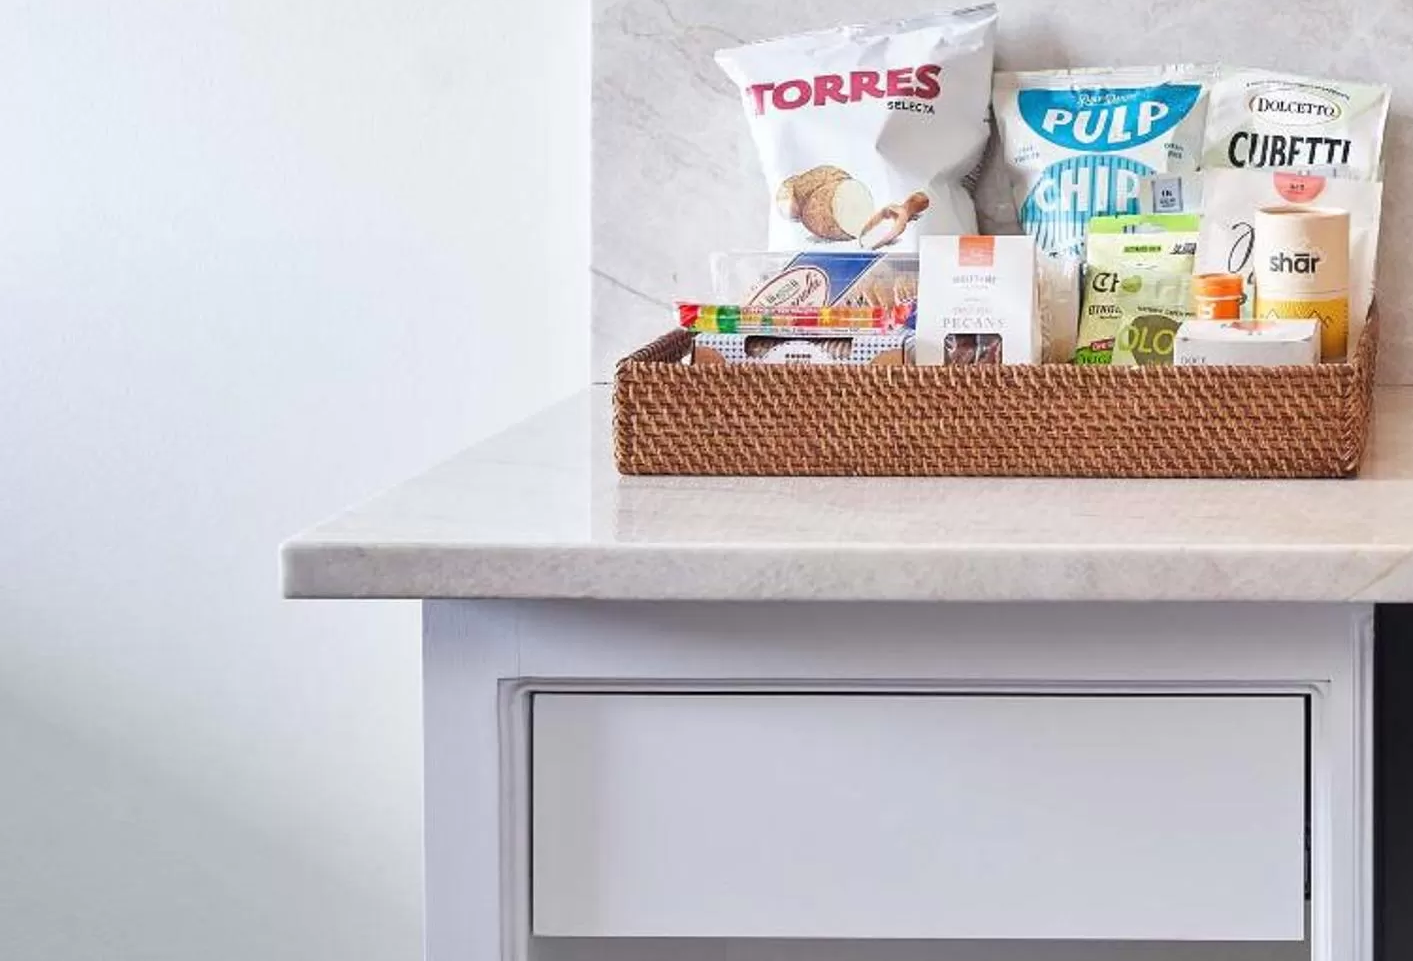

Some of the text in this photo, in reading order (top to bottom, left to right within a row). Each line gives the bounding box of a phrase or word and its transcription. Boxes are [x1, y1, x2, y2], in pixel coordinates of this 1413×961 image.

[746, 63, 943, 116] TORRES
[887, 100, 936, 115] SELECTA
[1257, 97, 1336, 117] DOLCETTO
[1041, 100, 1169, 144] PULP
[1034, 164, 1141, 212] CHIP
[1117, 324, 1175, 356] OLO
